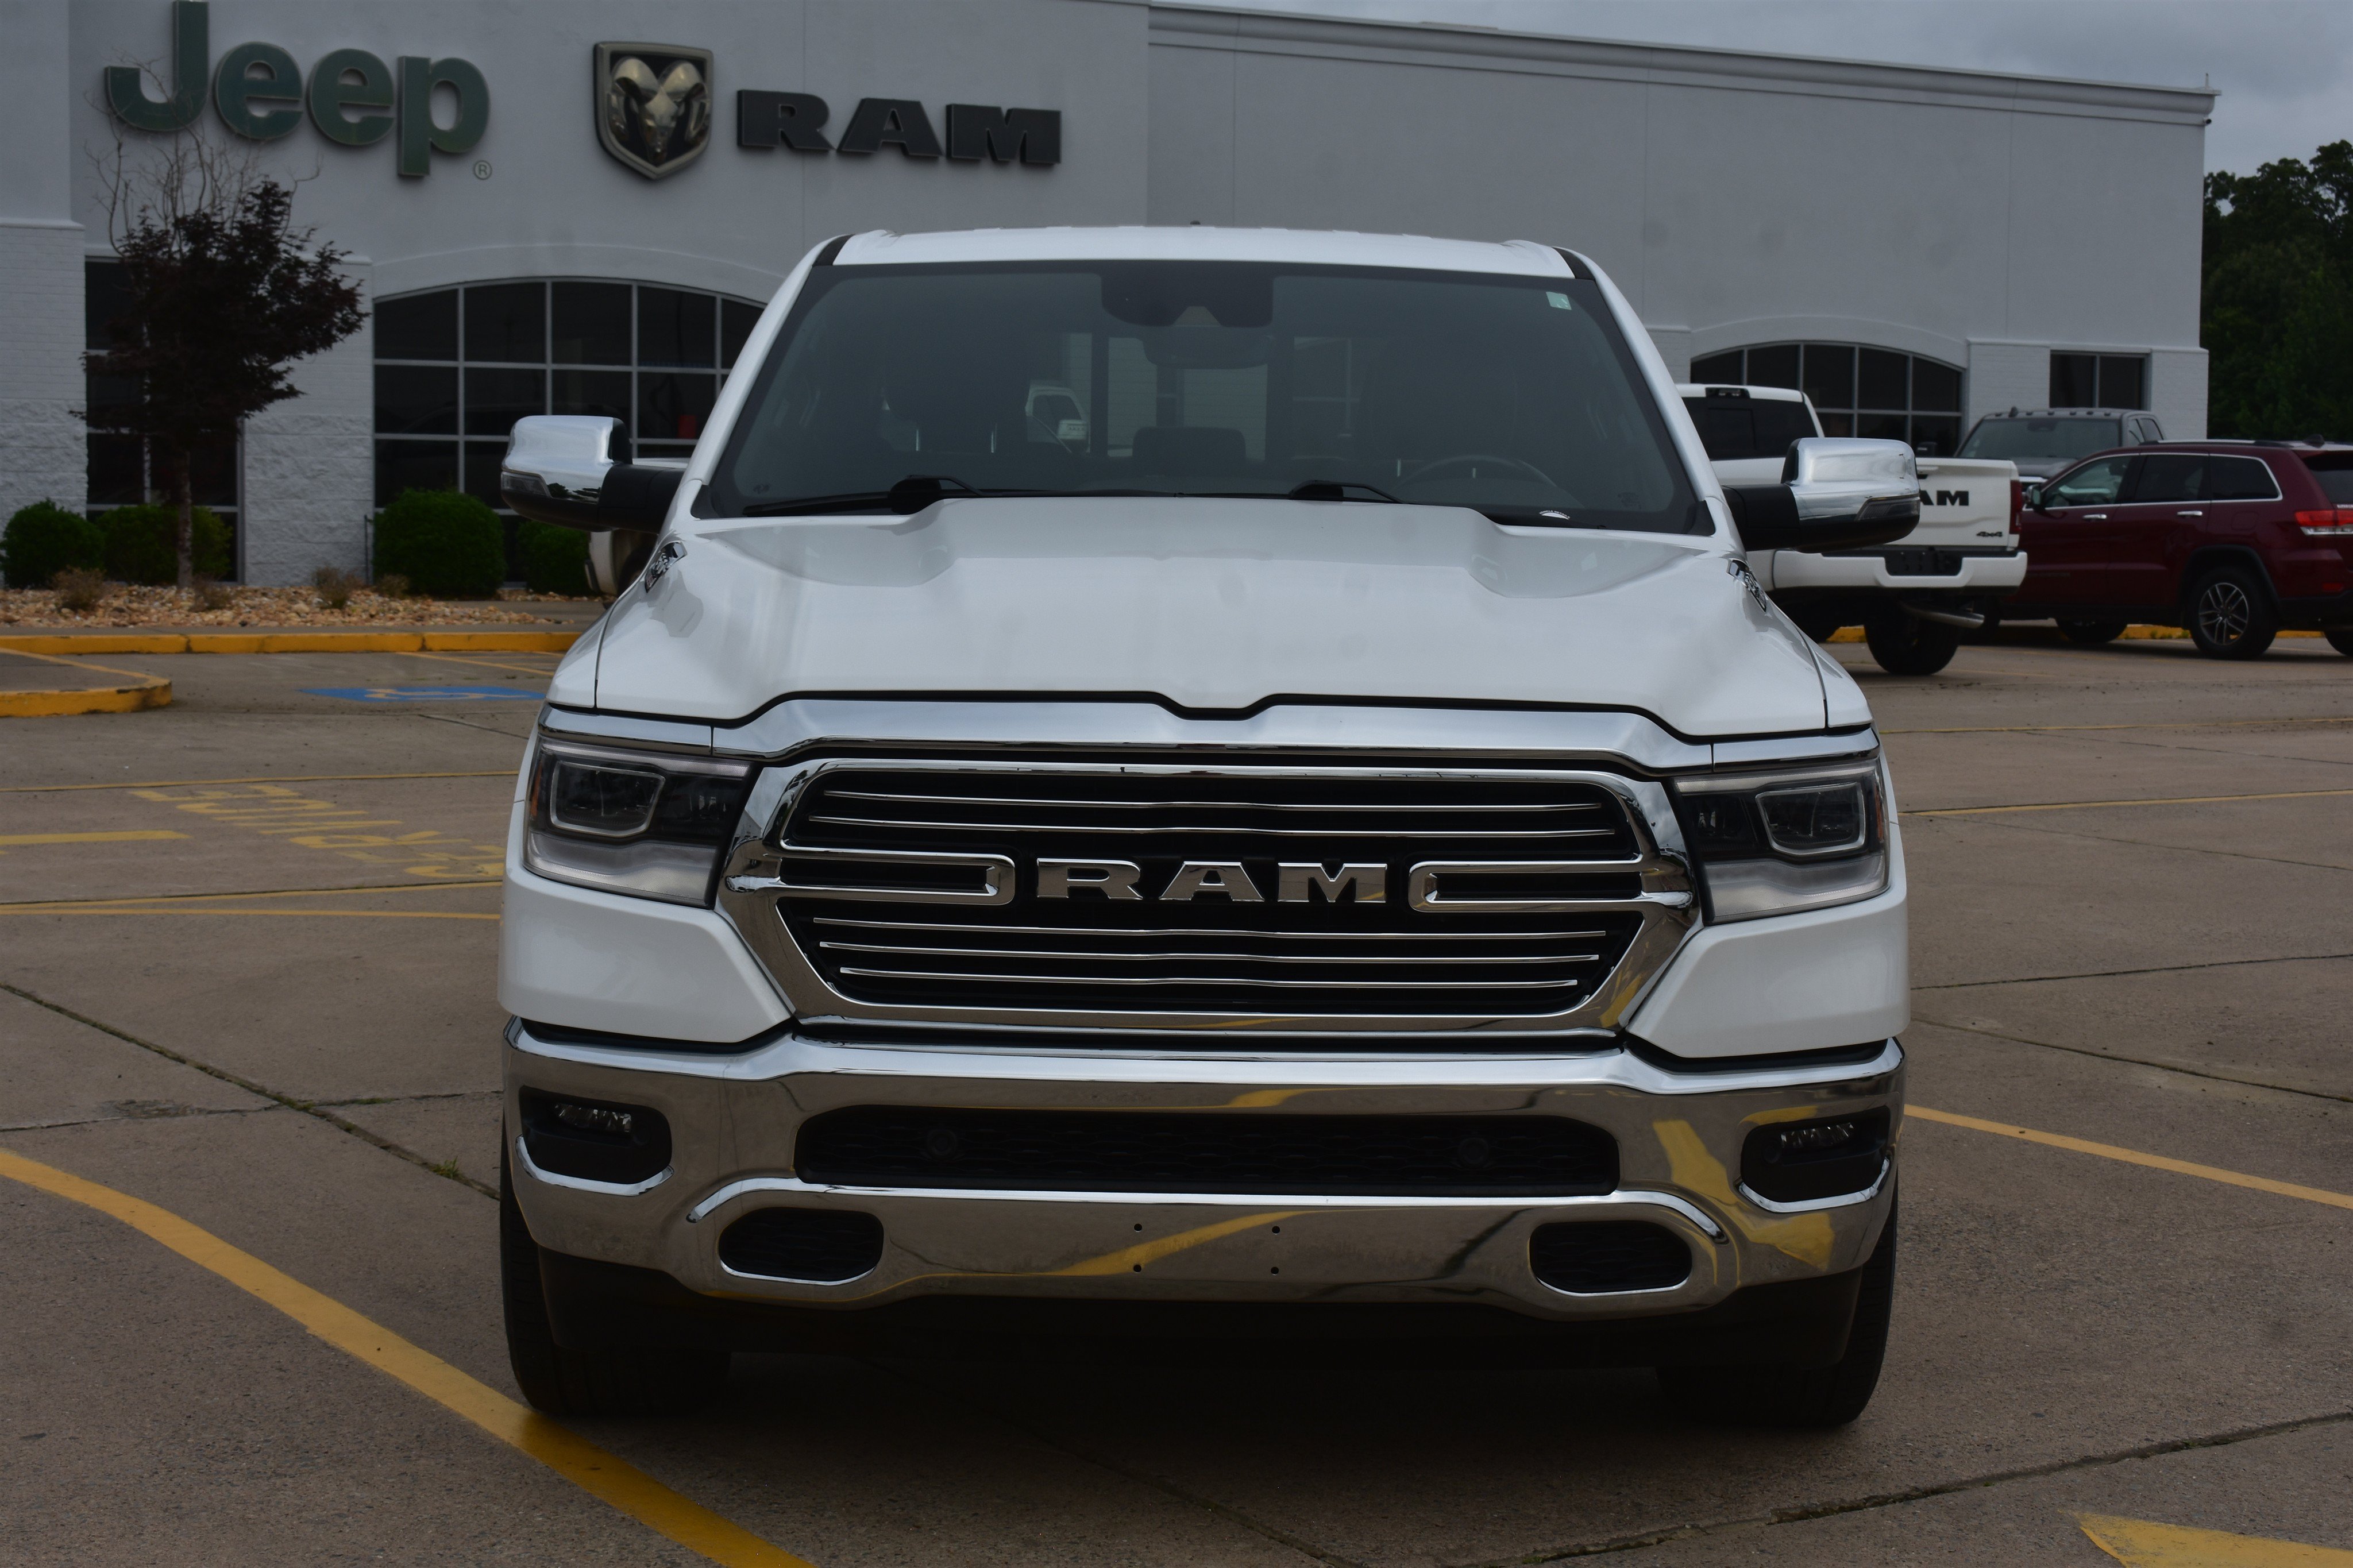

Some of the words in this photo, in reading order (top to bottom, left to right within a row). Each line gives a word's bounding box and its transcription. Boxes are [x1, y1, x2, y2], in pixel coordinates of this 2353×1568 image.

[104, 1, 491, 176] Jeep
[737, 89, 1062, 164] RAM
[1036, 858, 1388, 903] RAM
